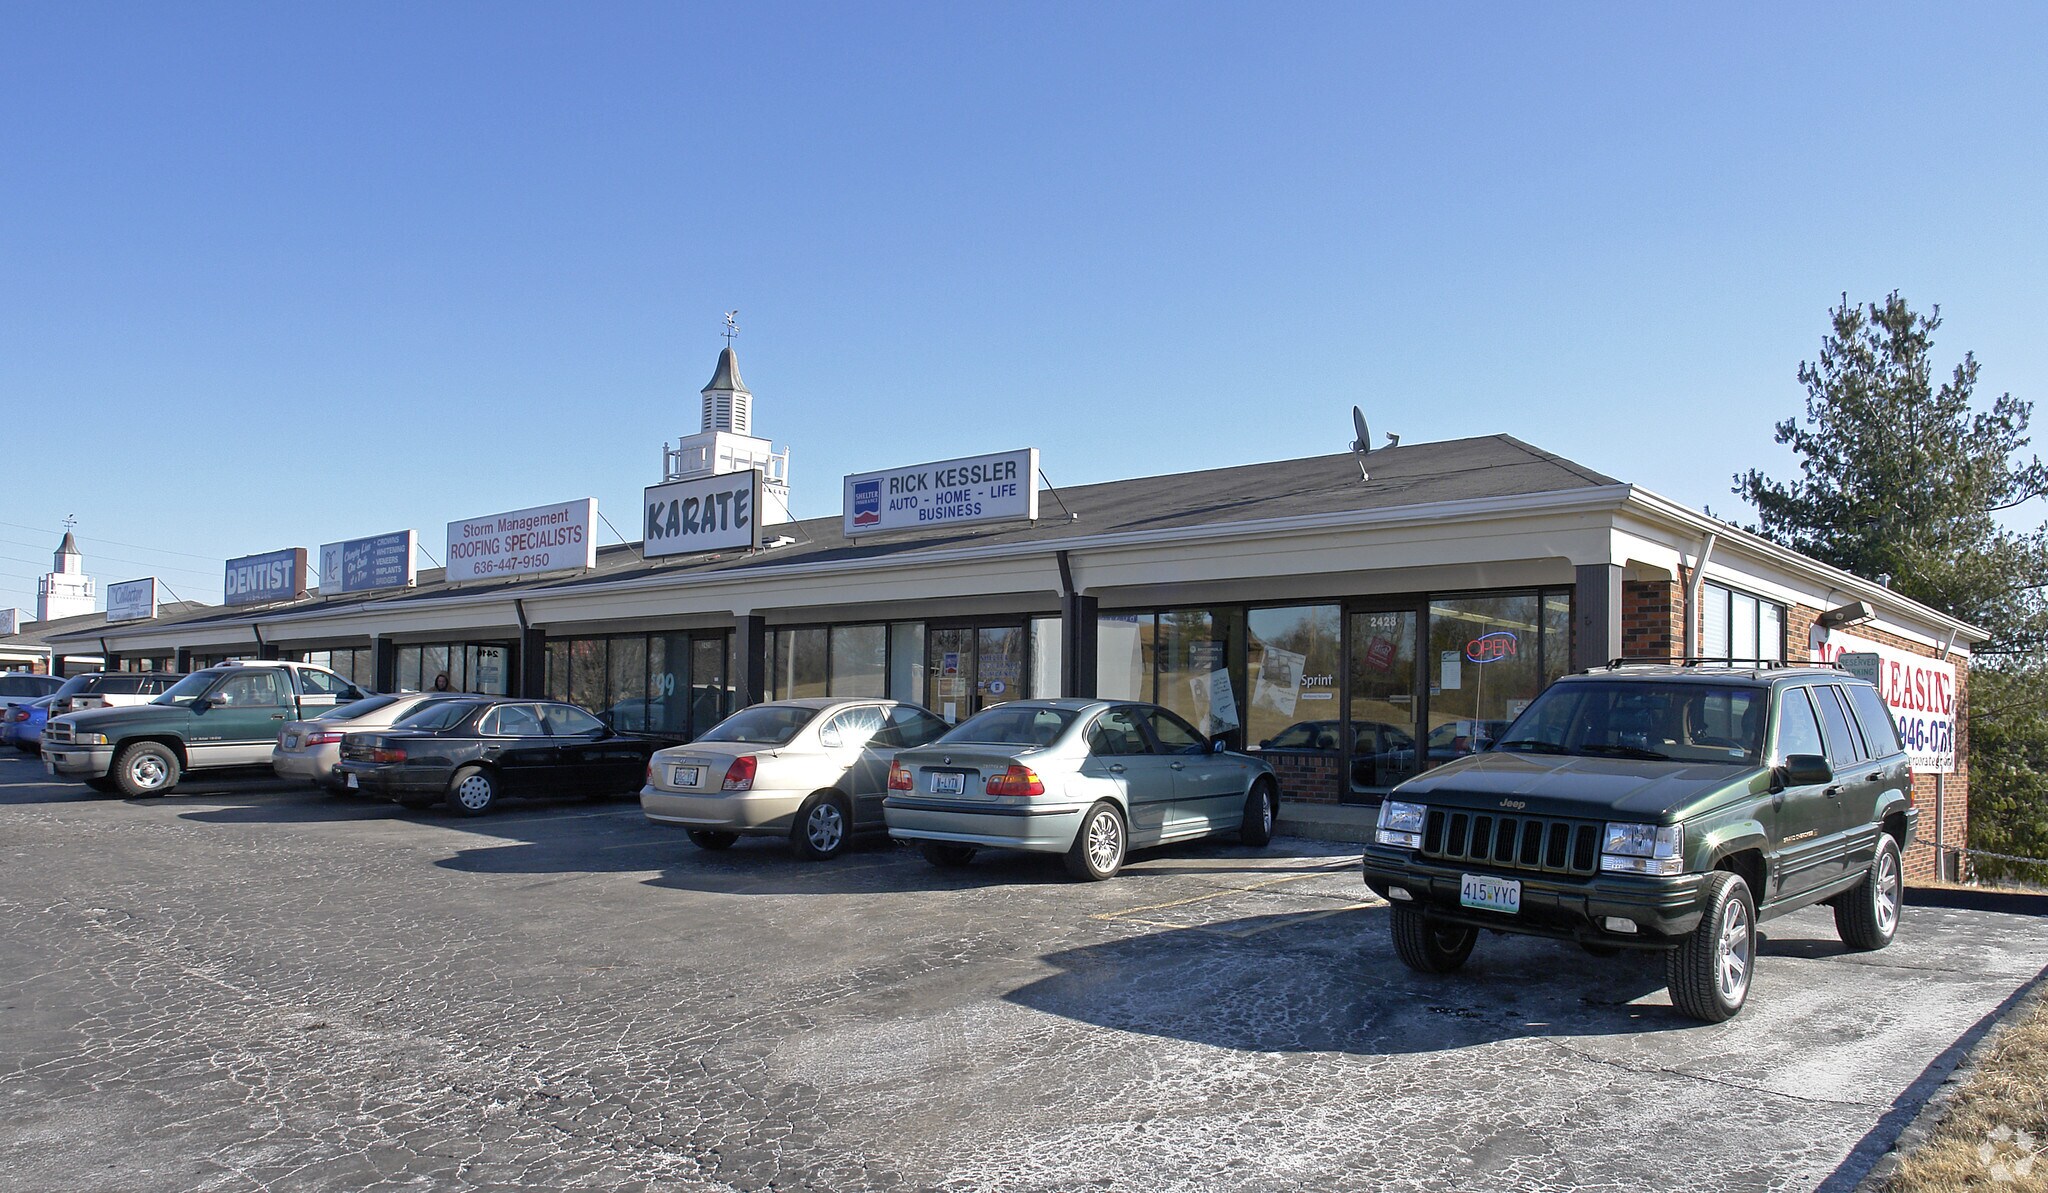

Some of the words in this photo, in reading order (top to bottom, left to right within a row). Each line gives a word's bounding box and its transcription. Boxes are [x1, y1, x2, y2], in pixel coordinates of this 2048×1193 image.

[889, 472, 928, 495] RICK
[935, 460, 1017, 489] KESSLER
[855, 491, 879, 500] SHELTER
[889, 496, 918, 511] AUTO
[935, 489, 971, 505] HOME
[990, 483, 1017, 499] LIFE
[648, 488, 750, 540] KARATE
[919, 502, 982, 521] BUSINESS
[463, 522, 494, 539] Storm
[497, 508, 569, 532] Management
[376, 544, 406, 556] WHITENING
[450, 537, 500, 560] ROOFING
[504, 524, 583, 553] SPECIALISTS
[375, 565, 402, 575] IMPLANTS
[473, 552, 550, 575] 636-447-9150
[226, 560, 294, 596] DENTIST
[1370, 616, 1397, 627] 2428
[1466, 639, 1517, 658] OPEN
[1840, 658, 1877, 667] RESERVED
[1301, 673, 1333, 688] Sprint
[1879, 657, 1952, 716] LEASING
[1499, 798, 1526, 810] Jeep
[1463, 882, 1487, 901] 415
[1493, 885, 1517, 905] YYC
